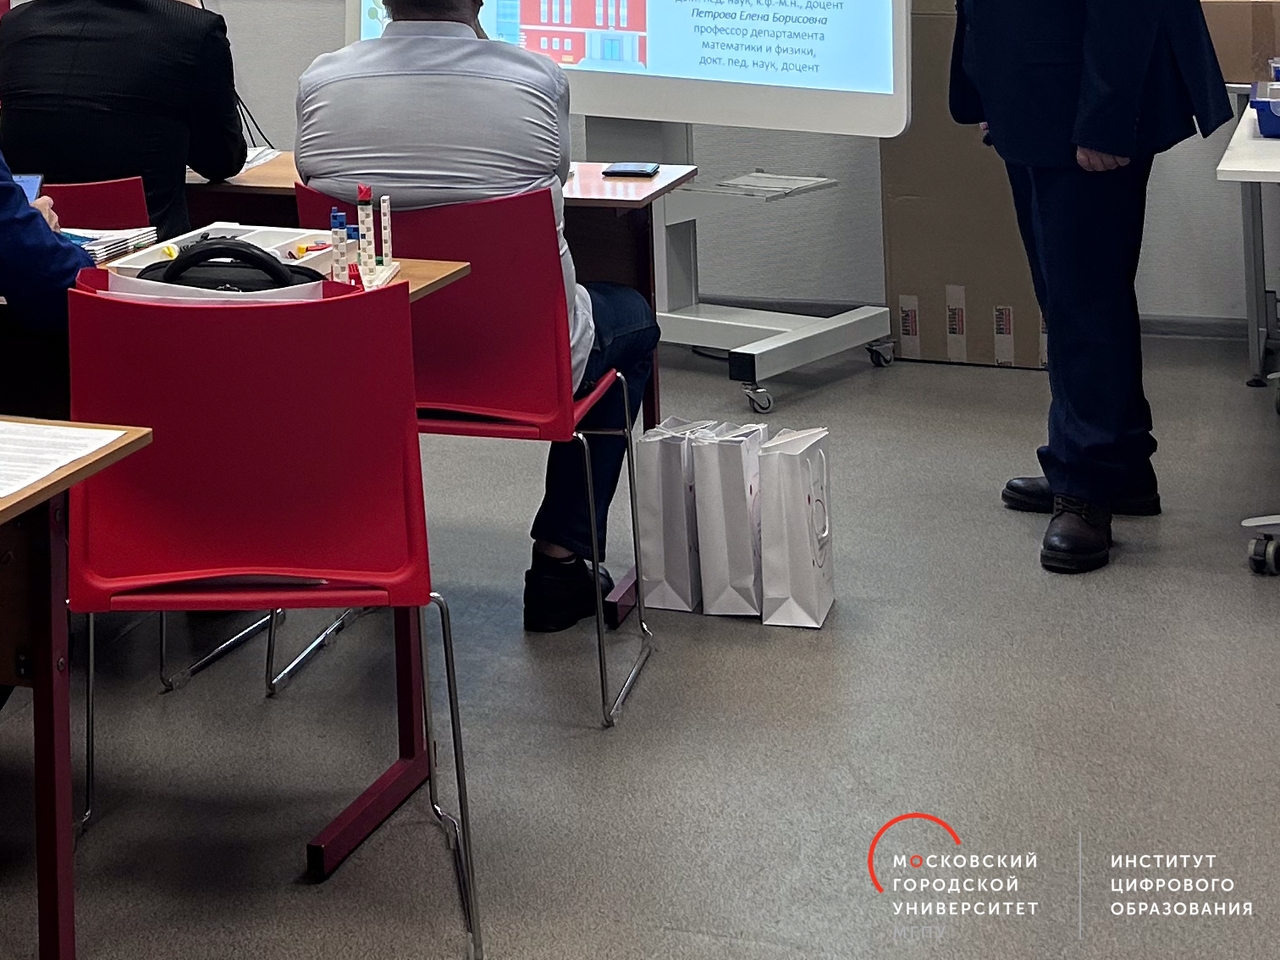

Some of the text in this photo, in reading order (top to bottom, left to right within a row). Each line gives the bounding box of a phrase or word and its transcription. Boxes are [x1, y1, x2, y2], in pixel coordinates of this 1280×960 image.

[805, 0, 844, 11] доцент
[691, 8, 827, 25] Петрова Елена Борисовна
[694, 24, 825, 41] профессор департамента
[701, 41, 763, 53] математики
[774, 44, 816, 58] физики,
[752, 60, 778, 71] наук,
[781, 62, 820, 74] доцент
